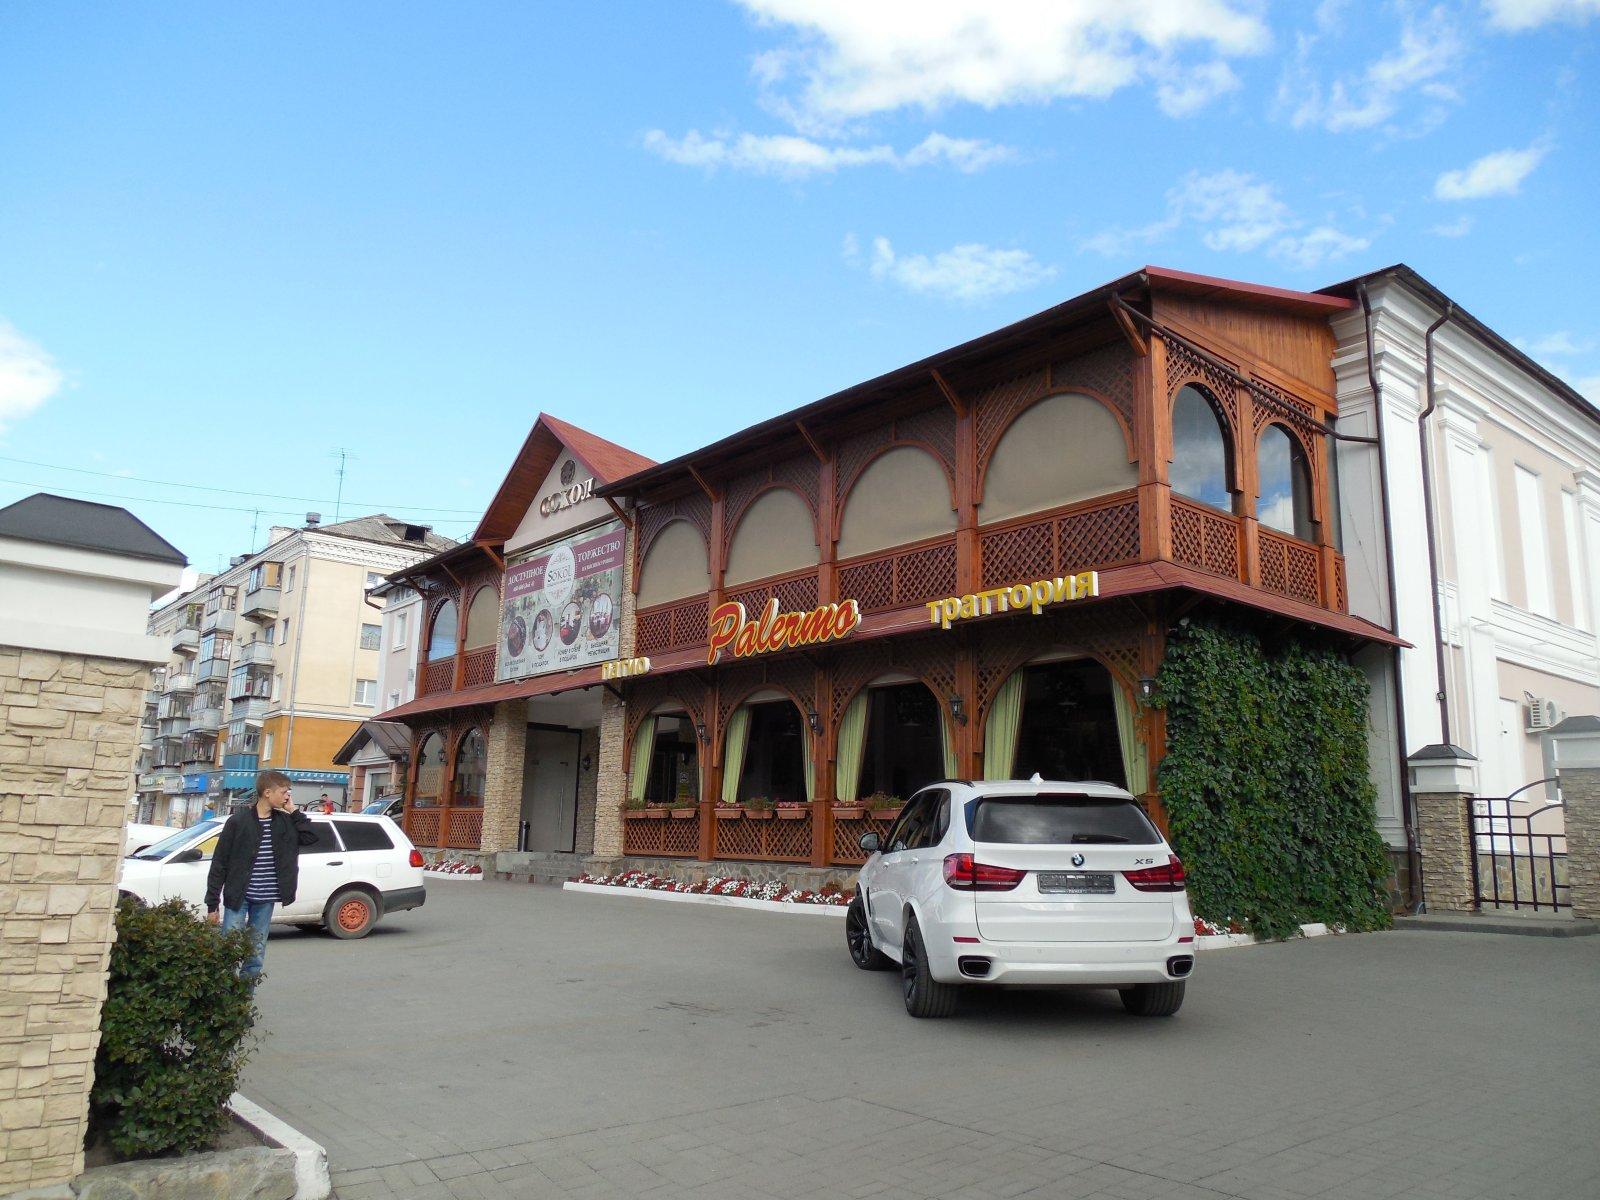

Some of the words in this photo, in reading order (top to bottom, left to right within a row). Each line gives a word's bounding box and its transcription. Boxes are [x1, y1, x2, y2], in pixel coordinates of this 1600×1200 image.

[540, 478, 595, 516] СОКОЛ
[577, 541, 621, 562] ТОРЖЕСТВО
[926, 571, 1099, 629] траттория
[708, 598, 861, 665] Palermo
[601, 657, 650, 679] патио
